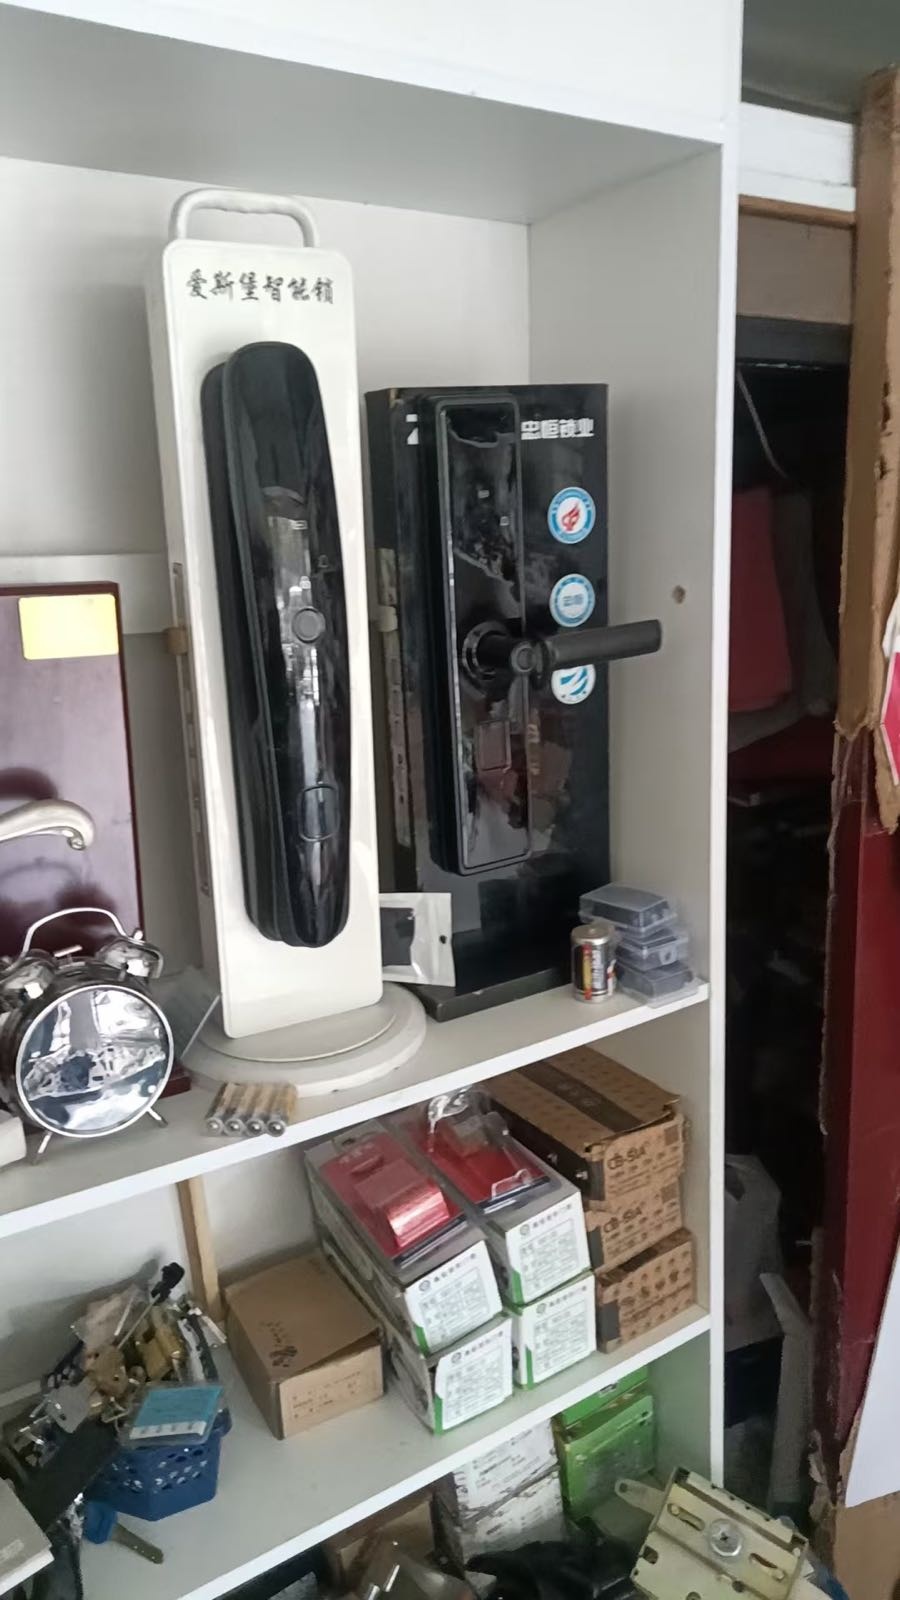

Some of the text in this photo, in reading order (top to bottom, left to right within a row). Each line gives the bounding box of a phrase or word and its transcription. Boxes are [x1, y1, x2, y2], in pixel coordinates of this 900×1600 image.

[186, 268, 334, 304] 爱斯堡智能锁
